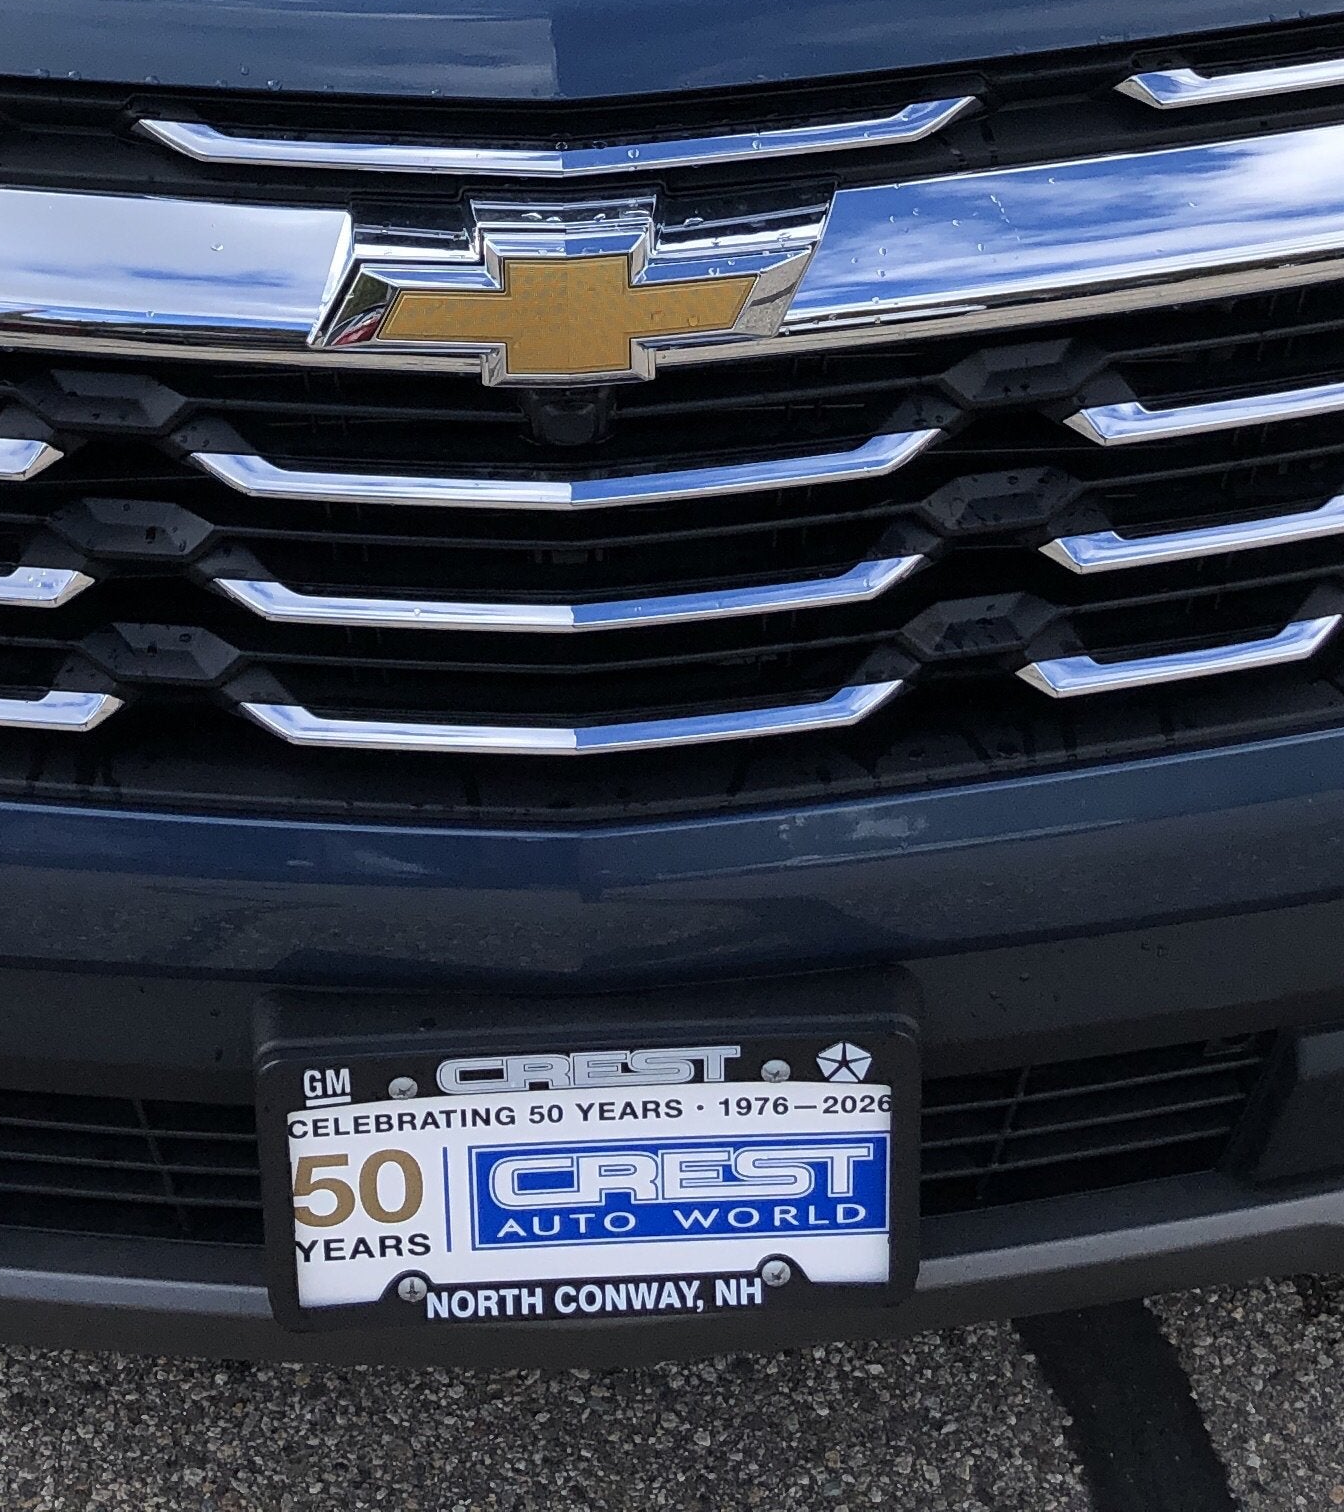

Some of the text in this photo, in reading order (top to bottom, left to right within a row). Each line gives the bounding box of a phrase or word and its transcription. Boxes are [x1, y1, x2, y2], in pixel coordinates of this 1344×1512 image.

[303, 1068, 352, 1099] GM
[436, 1045, 741, 1095] CREST
[287, 1105, 517, 1140] CELEBRATING
[528, 1102, 565, 1125] 50
[575, 1098, 684, 1123] YEARS
[293, 1148, 424, 1228] 50
[488, 1142, 875, 1211] CREST
[496, 1203, 867, 1239] AUTO WORLD
[295, 1232, 432, 1263] YEARS
[426, 1277, 763, 1320] NORTH CONWAY, NH
